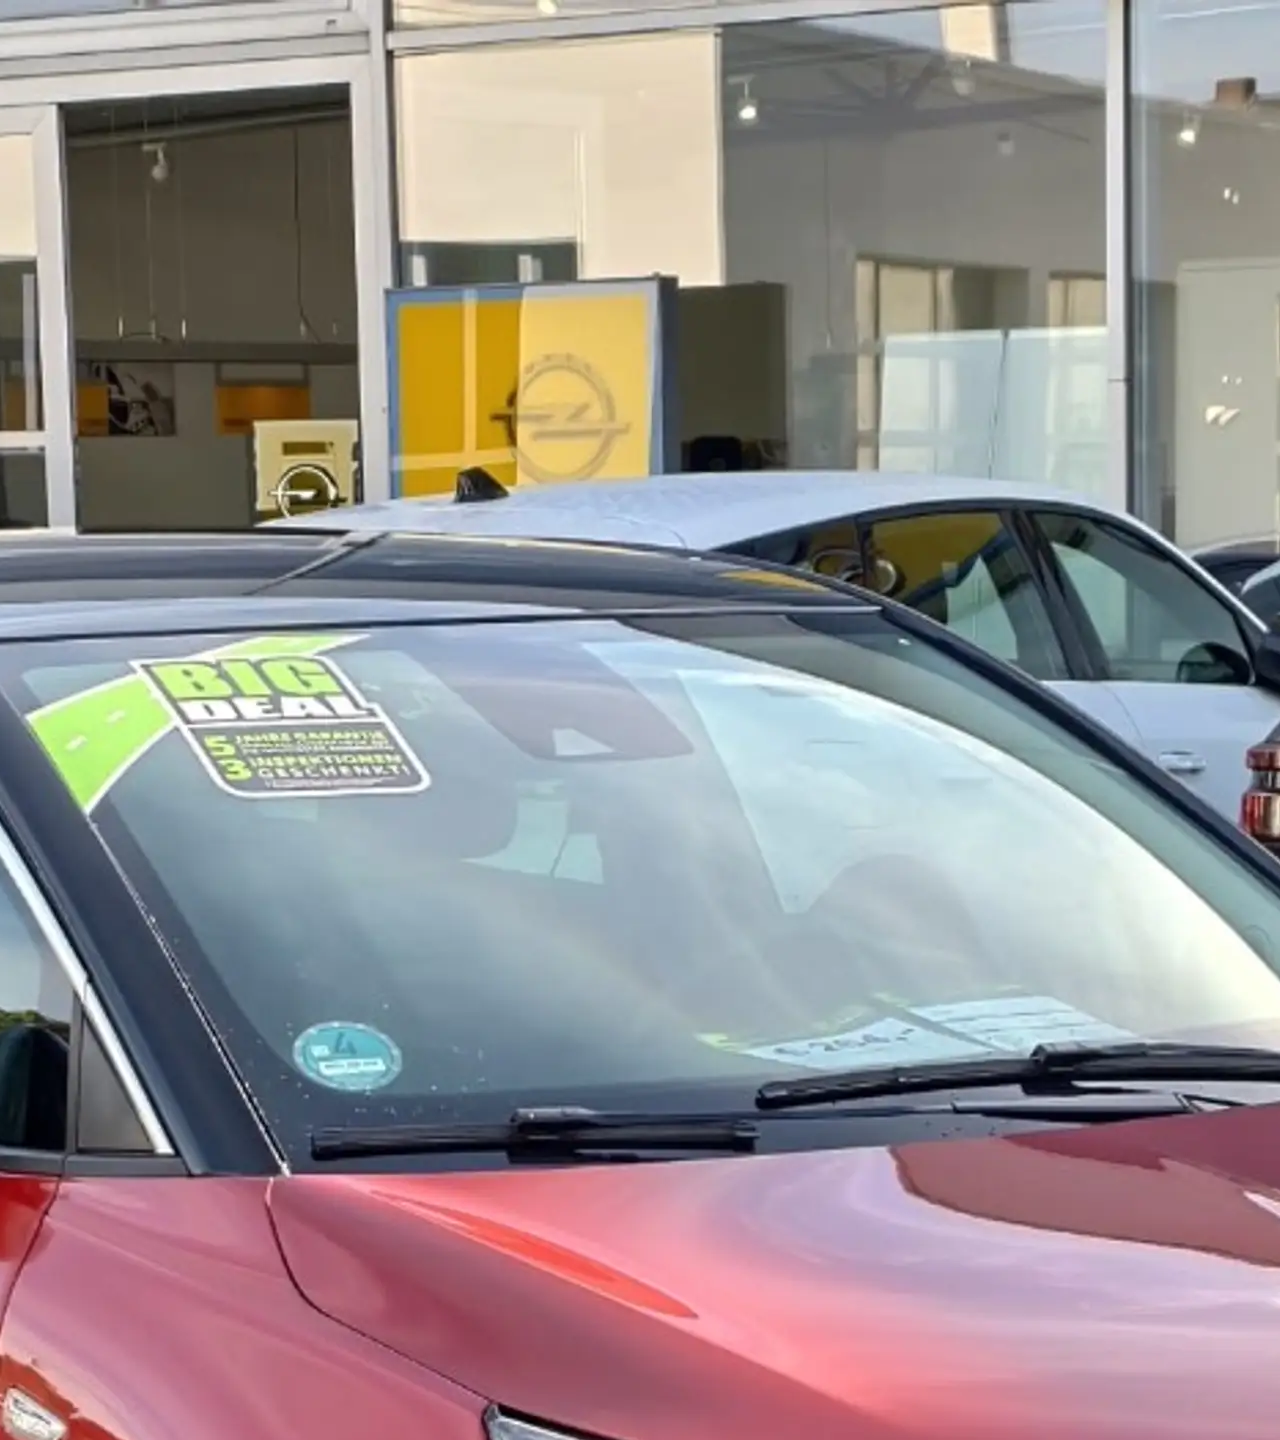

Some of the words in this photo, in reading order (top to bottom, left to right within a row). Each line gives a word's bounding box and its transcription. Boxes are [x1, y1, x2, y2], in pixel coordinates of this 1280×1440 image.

[149, 657, 344, 699] BIG
[177, 695, 370, 721] DEAL
[204, 735, 236, 756] 5
[217, 760, 253, 781] 3
[249, 753, 402, 768] INSPEKTIONEN
